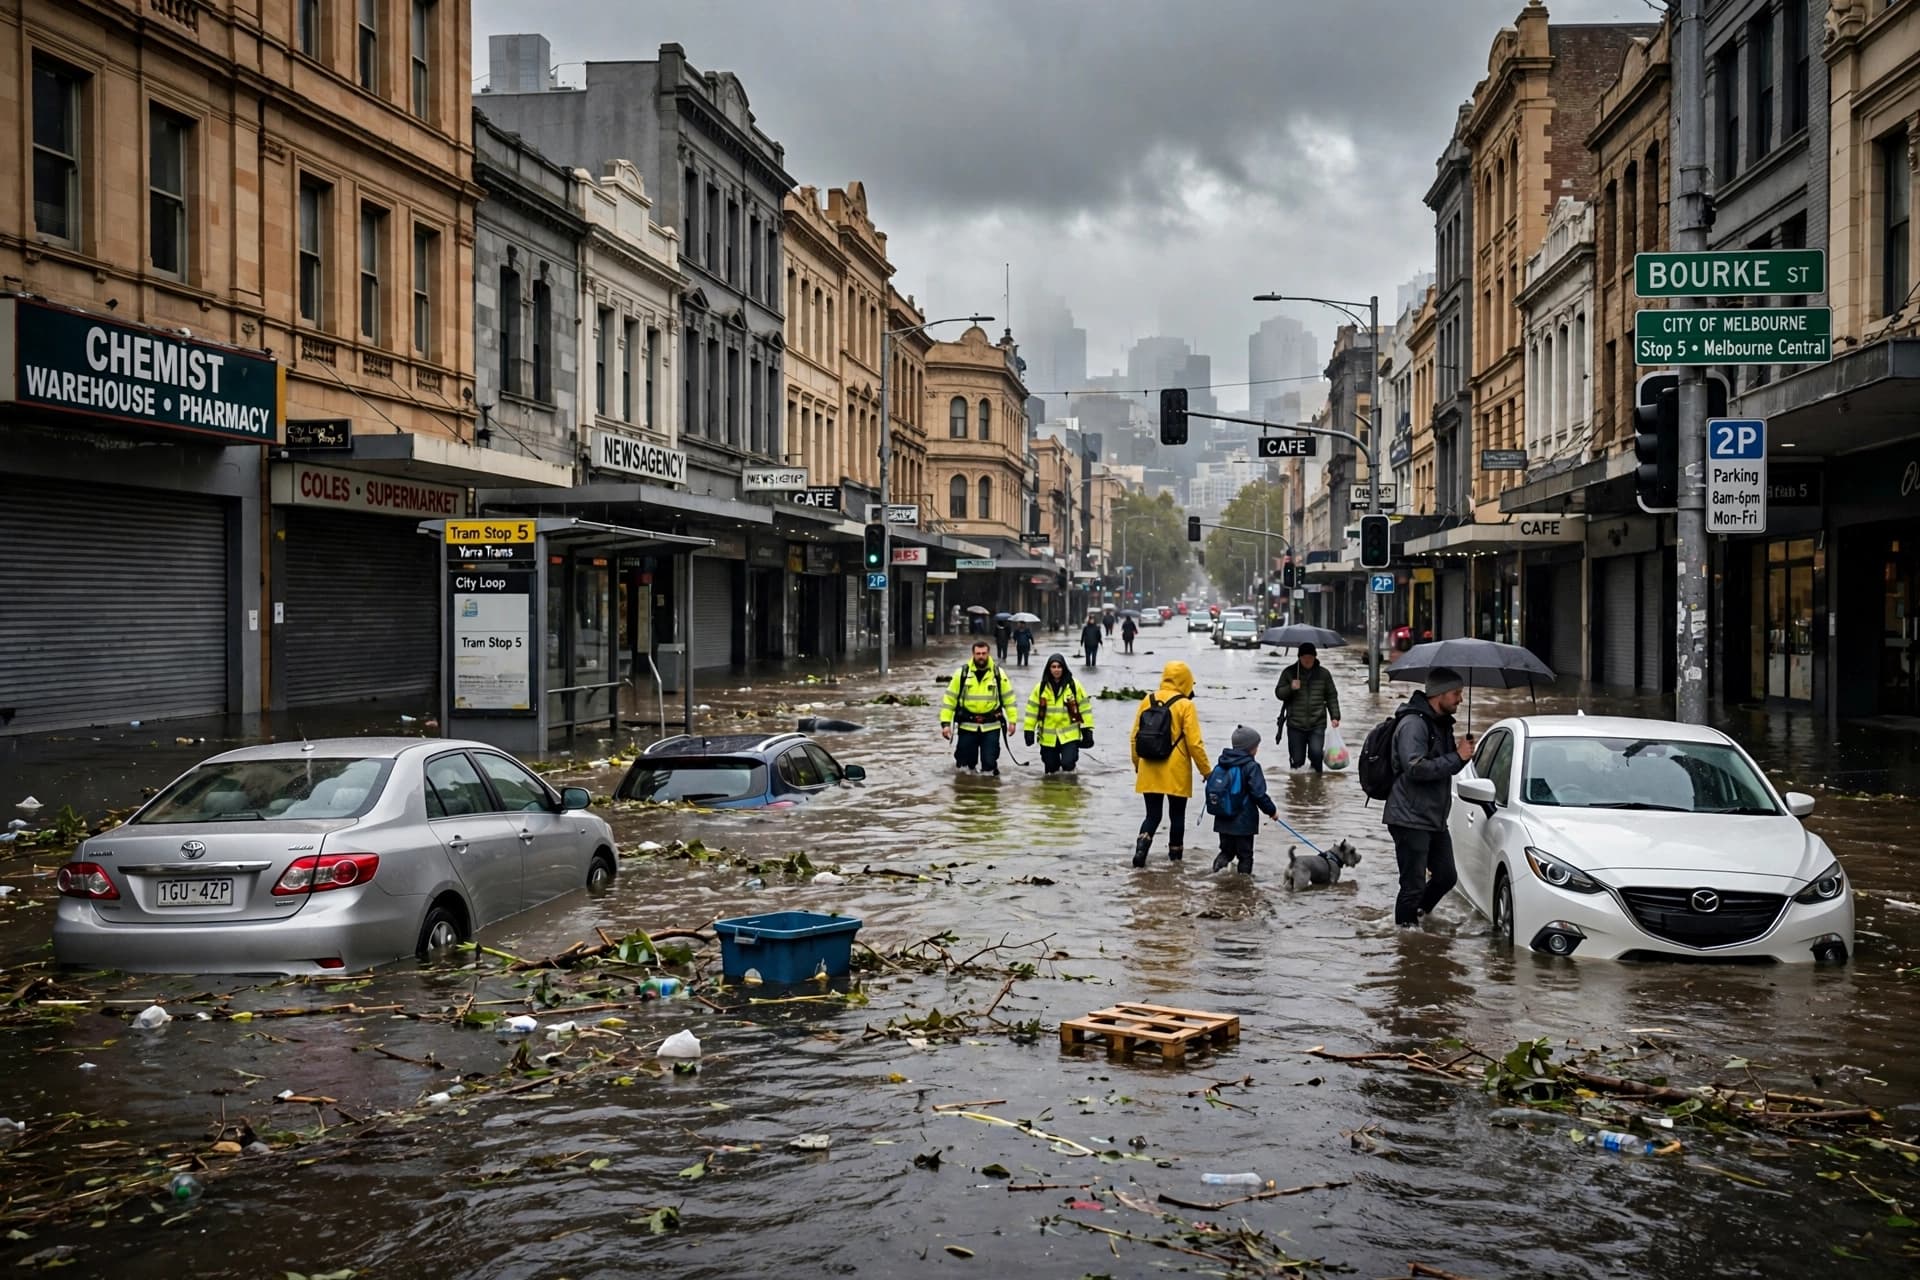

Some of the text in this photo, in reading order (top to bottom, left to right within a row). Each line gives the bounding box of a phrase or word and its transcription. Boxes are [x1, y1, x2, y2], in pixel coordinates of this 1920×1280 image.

[1649, 260, 1810, 289] BOURKE ST
[1663, 315, 1807, 333] CITY OF MELBOURNE
[1641, 338, 1826, 360] Stop 5 Melbourne Central
[86, 326, 224, 394] CHEMIST
[26, 364, 270, 434] WAREHOUSE PHARMACY
[1266, 440, 1307, 455] CAFE
[1716, 427, 1757, 454] 2P
[604, 436, 684, 479] NEWSAGENCY
[1714, 468, 1759, 486] Parking
[301, 471, 459, 514] COLES SUPERMARKET
[793, 492, 834, 507] CAFE
[1712, 491, 1761, 508] 8am-6pm
[1713, 510, 1757, 525] Mon-Fri
[450, 524, 529, 542] Tram Stop 5
[1520, 520, 1561, 536] CAFE
[458, 545, 513, 558] Yarra Trams
[455, 576, 506, 591] City Loop
[870, 575, 886, 587] 2P
[1374, 577, 1392, 591] 2P
[461, 636, 522, 651] Tram Stop 5
